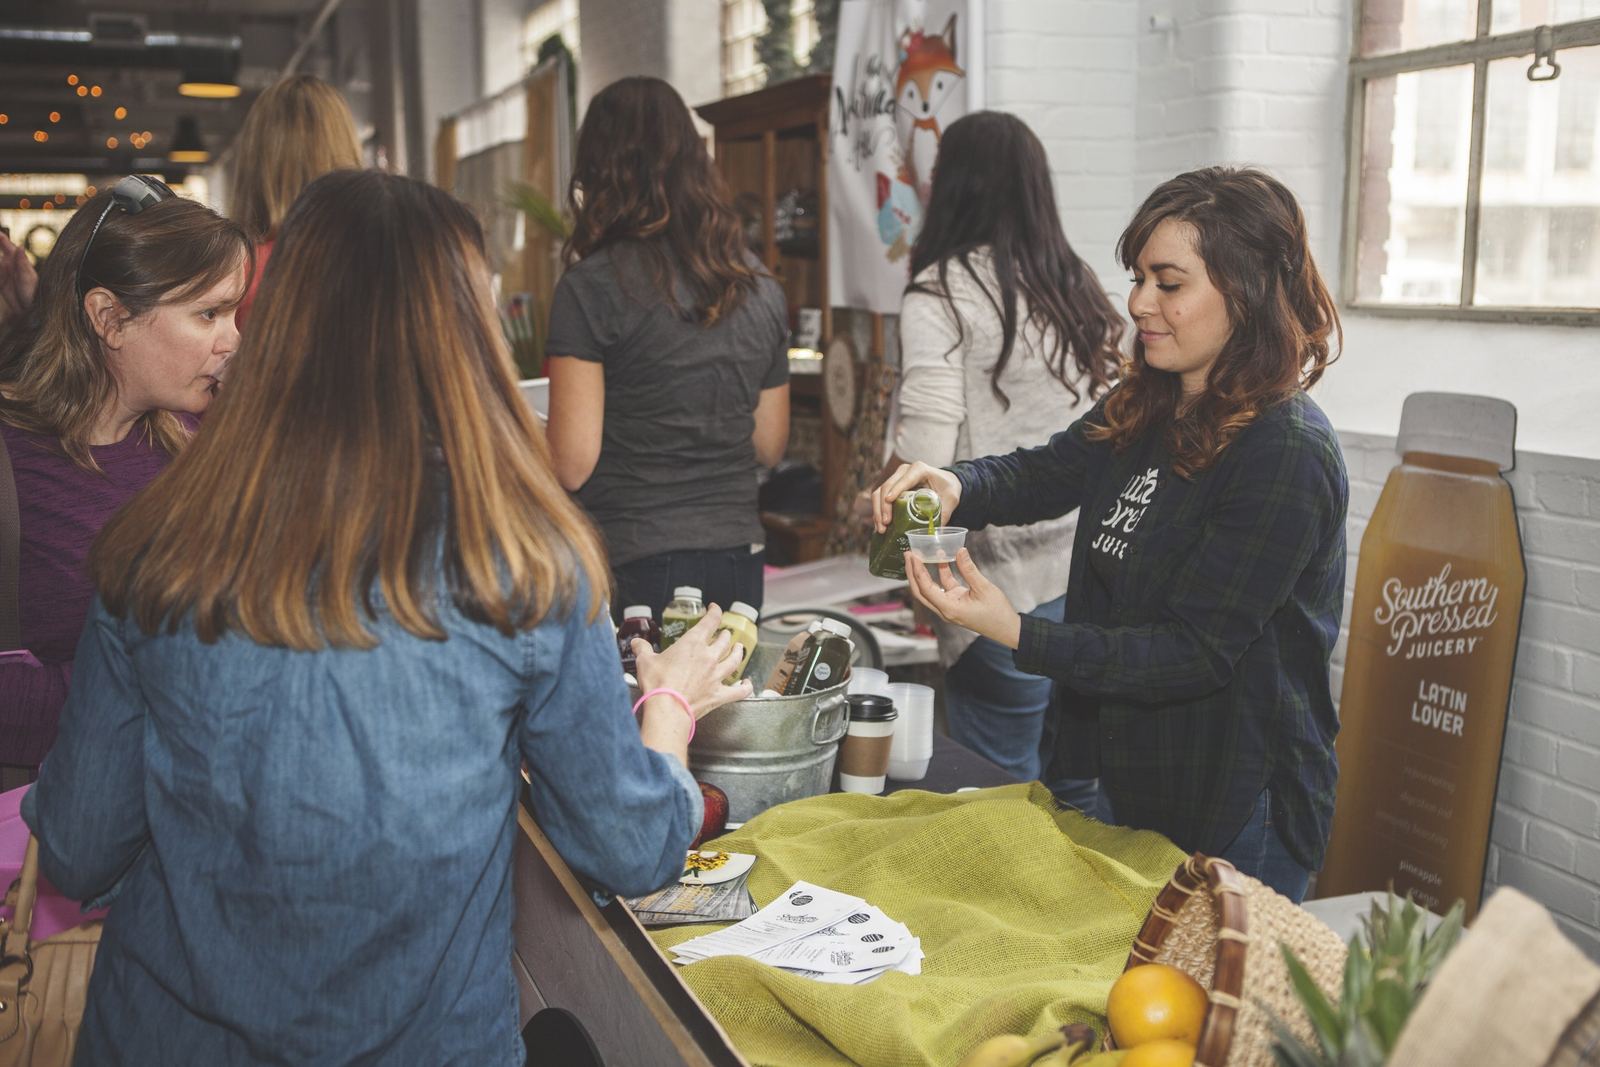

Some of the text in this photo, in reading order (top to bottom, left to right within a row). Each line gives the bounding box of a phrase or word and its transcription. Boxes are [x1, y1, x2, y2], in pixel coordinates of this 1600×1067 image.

[1375, 562, 1494, 624] Southern
[1387, 587, 1499, 656] Pressed
[1406, 636, 1478, 660] JUICERY
[1419, 679, 1468, 713] LATIN
[1411, 700, 1464, 737] LOVER
[1399, 860, 1442, 887] pineapple
